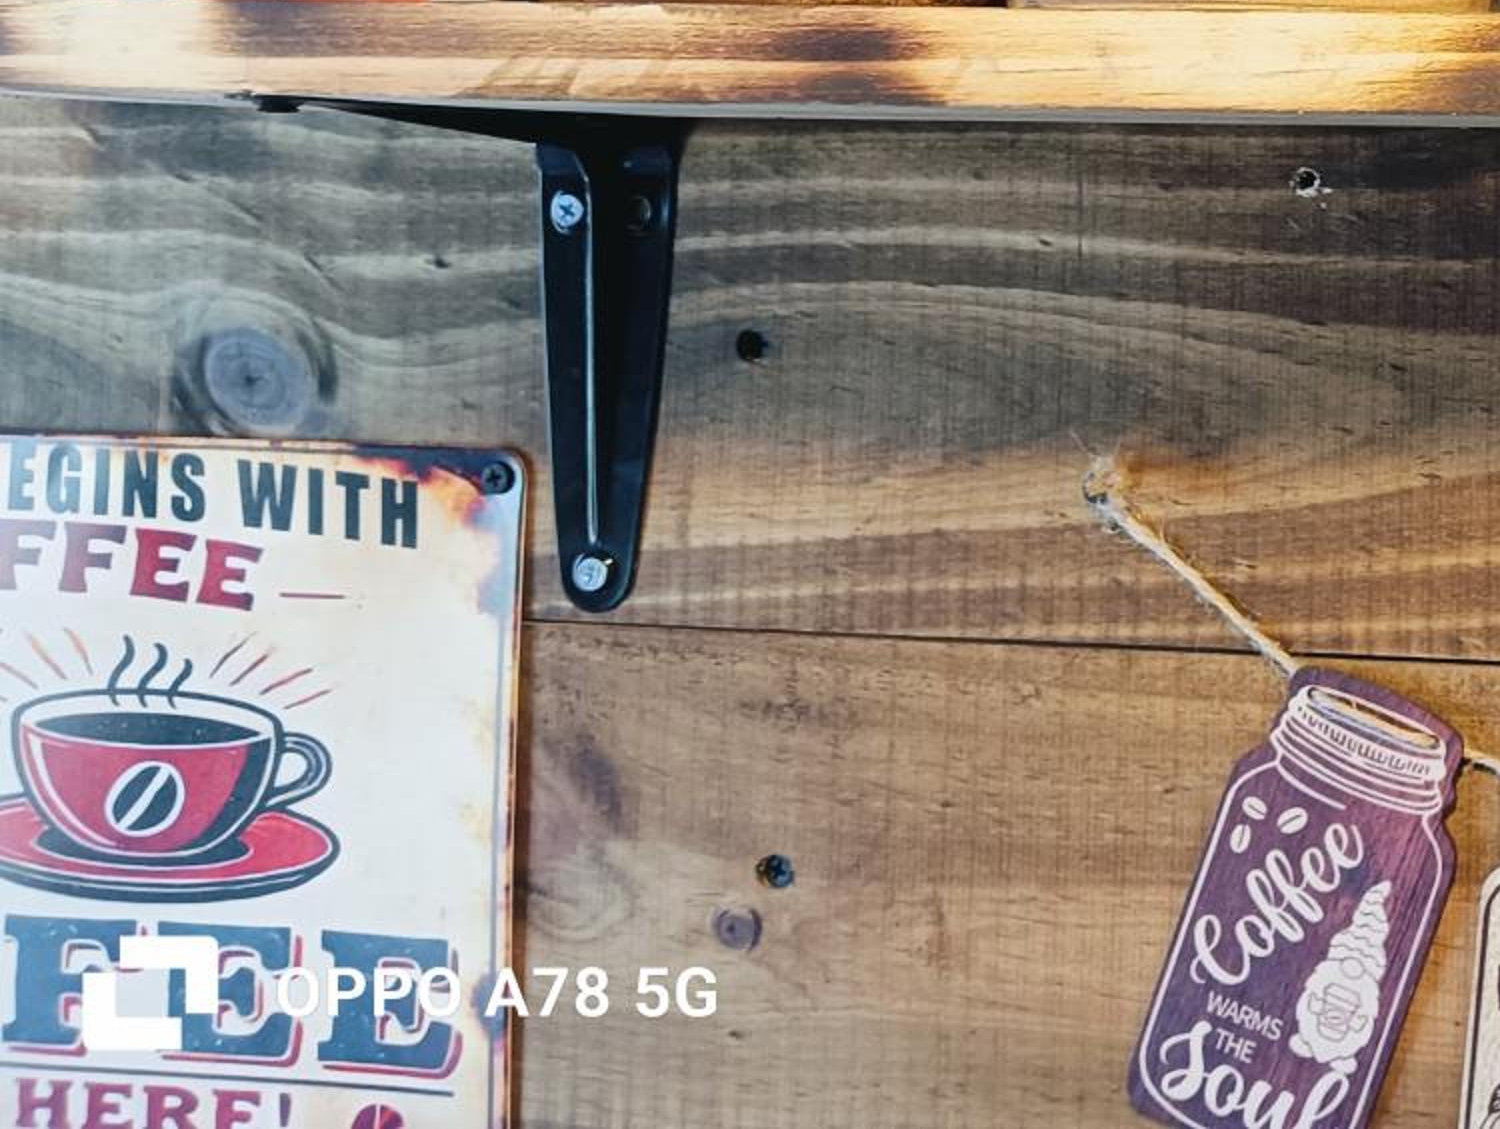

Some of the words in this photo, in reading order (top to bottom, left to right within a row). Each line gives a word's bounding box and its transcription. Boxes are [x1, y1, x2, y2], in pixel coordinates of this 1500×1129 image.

[237, 459, 418, 549] WITH
[1190, 821, 1365, 986] Coffee
[1206, 990, 1284, 1041] WARMS
[1215, 1028, 1257, 1064] THE
